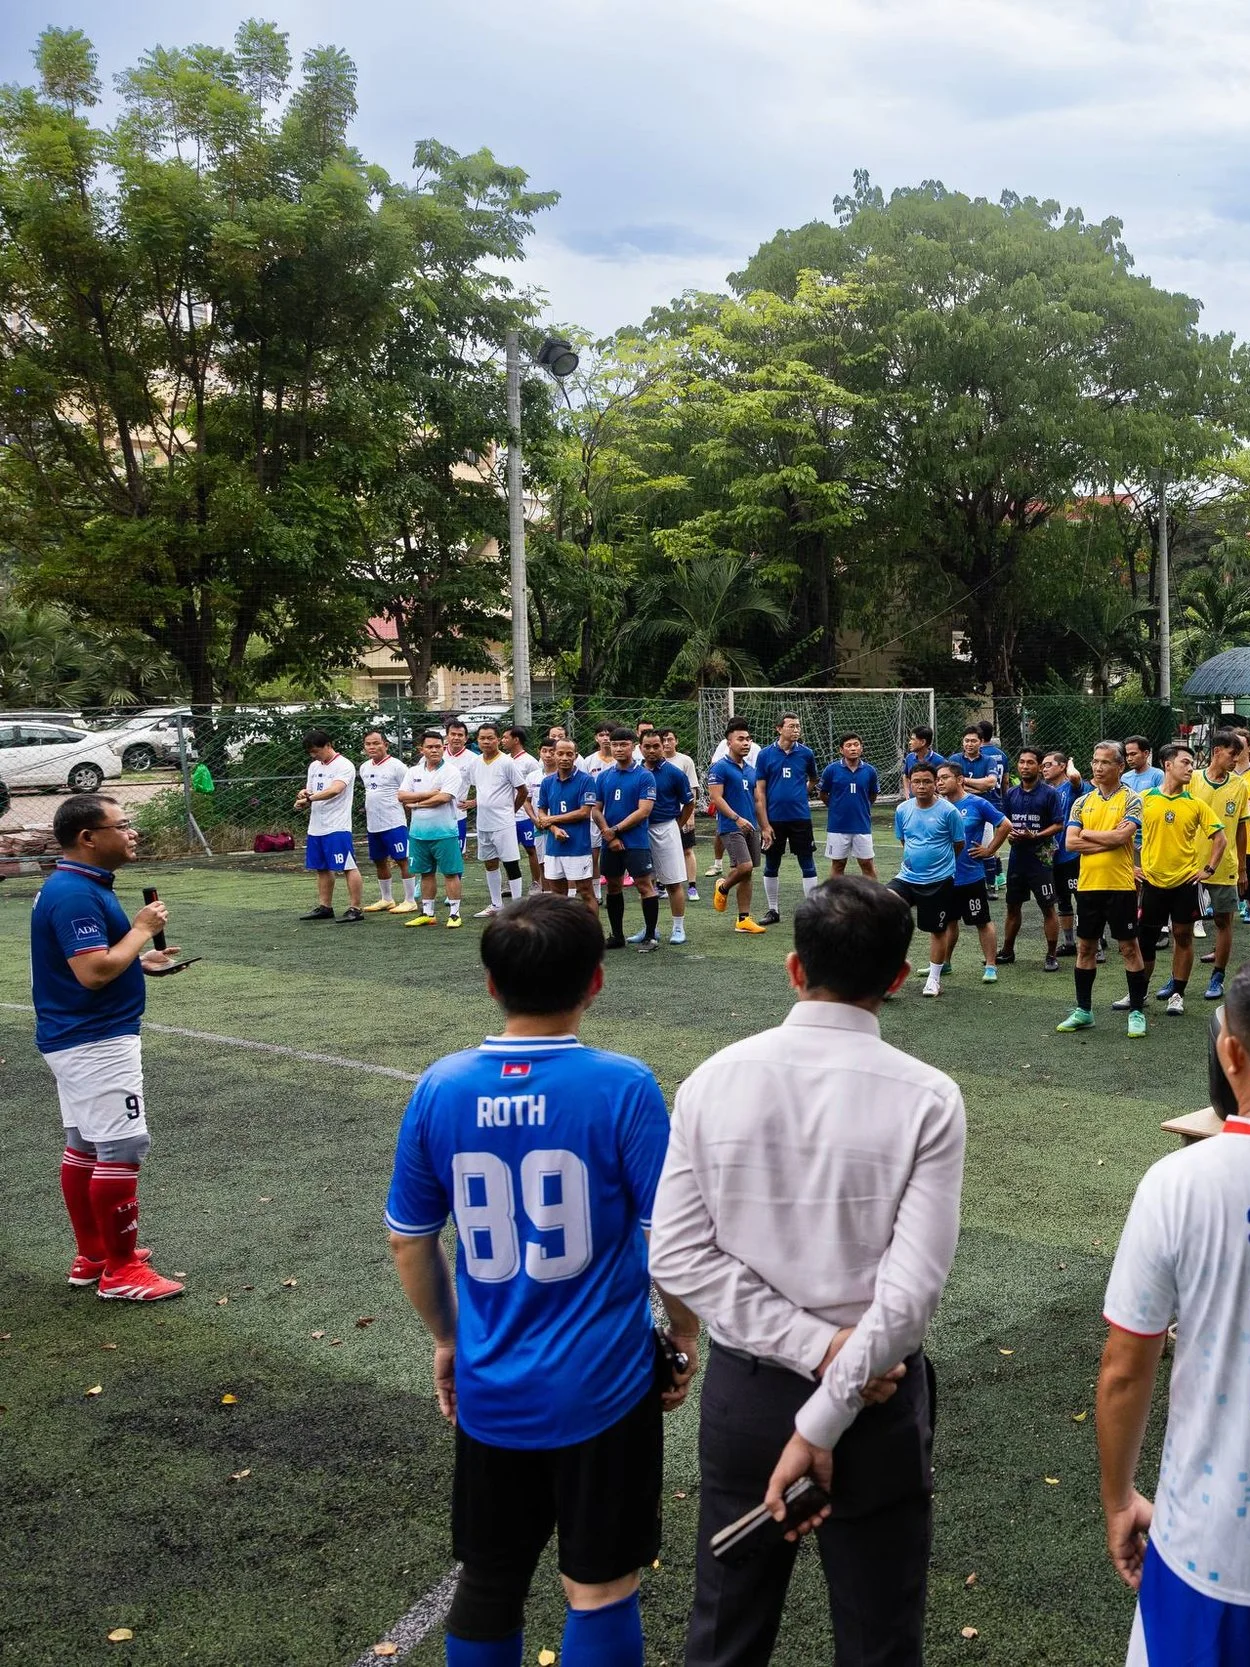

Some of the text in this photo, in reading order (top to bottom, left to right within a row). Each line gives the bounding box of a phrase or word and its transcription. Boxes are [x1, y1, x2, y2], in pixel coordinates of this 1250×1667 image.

[782, 767, 791, 778] 15
[850, 783, 856, 794] 11
[614, 789, 621, 800] 8
[560, 801, 567, 813] 6
[523, 831, 533, 841] 12
[393, 842, 404, 853] 10
[334, 853, 344, 864] 18
[1067, 879, 1077, 889] 69
[969, 898, 981, 911] 68
[939, 911, 946, 922] 9
[125, 1094, 140, 1120] 9
[476, 1094, 547, 1128] ROTH
[451, 1149, 593, 1284] 89
